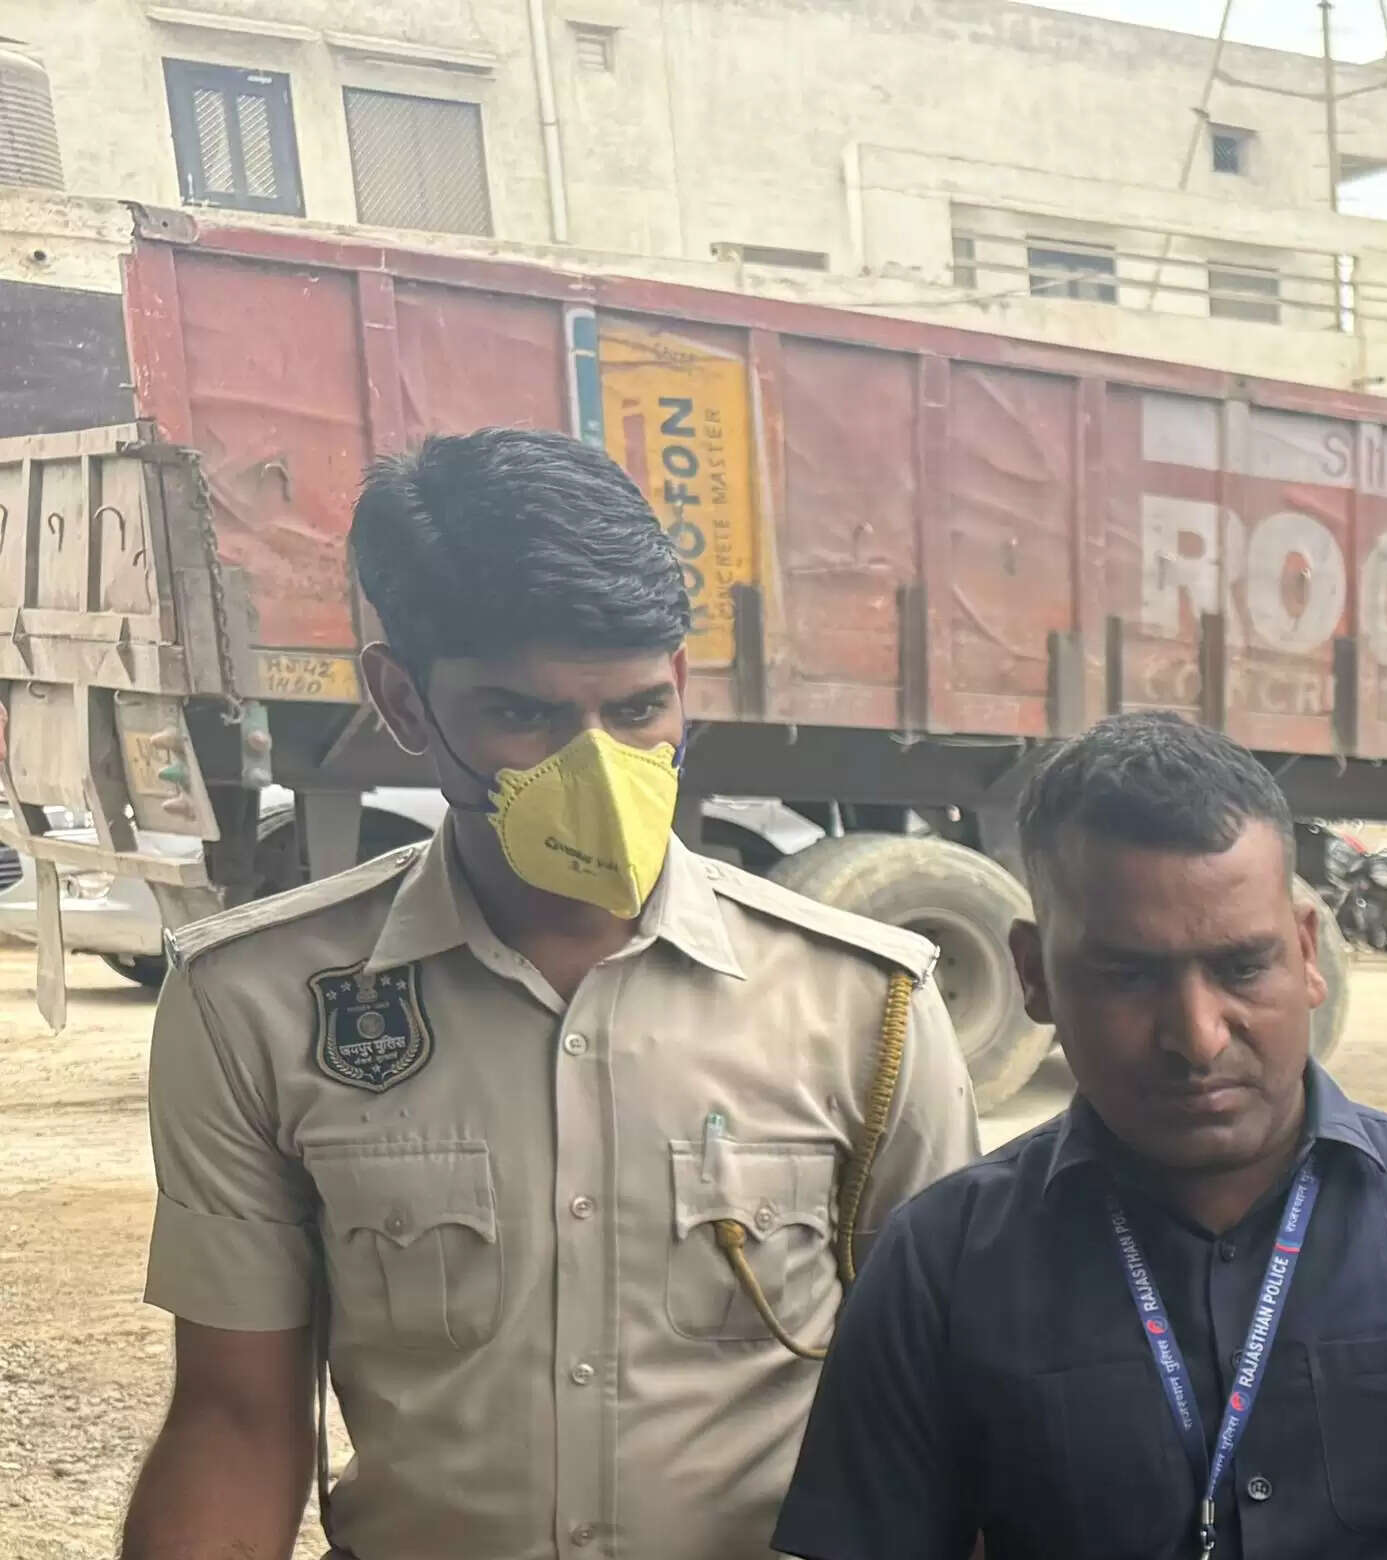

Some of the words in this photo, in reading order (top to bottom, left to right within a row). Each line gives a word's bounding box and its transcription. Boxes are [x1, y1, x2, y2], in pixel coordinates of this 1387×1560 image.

[1119, 1234, 1160, 1312] RAJASTHAN
[1238, 1307, 1275, 1387] RAJASTHAN
[1263, 1255, 1290, 1306] POLICE
